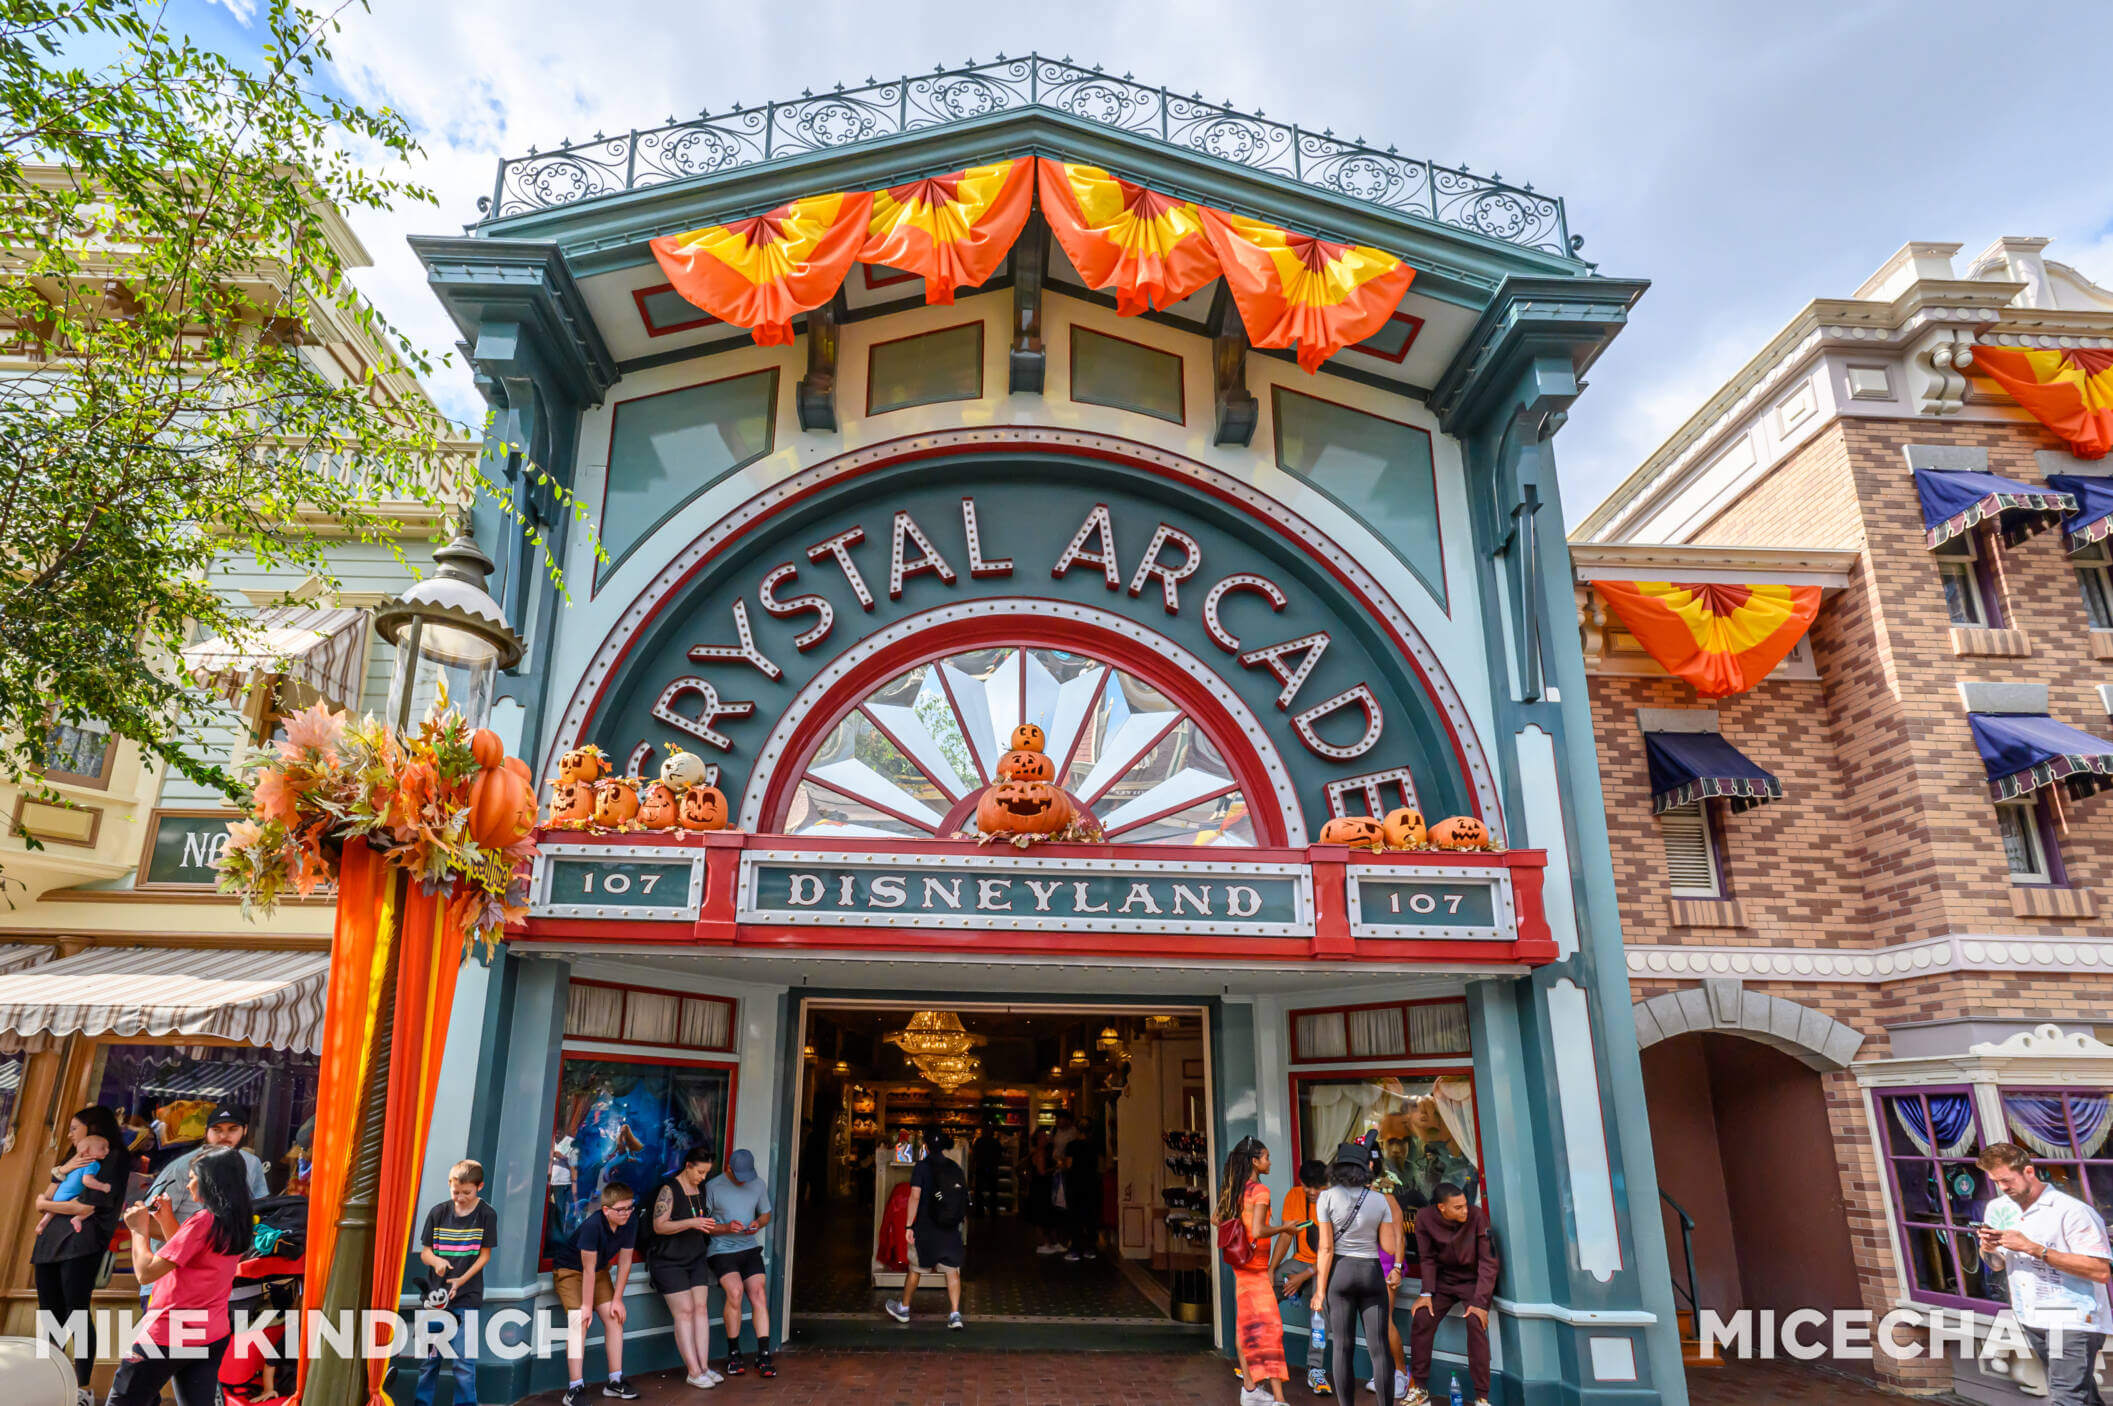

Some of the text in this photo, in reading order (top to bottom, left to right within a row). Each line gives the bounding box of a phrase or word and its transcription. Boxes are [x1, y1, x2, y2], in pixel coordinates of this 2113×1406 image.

[1052, 503, 1423, 824] ARCADE
[582, 871, 663, 895] 107
[787, 873, 1264, 917] DISNEYLAND
[1388, 891, 1465, 915] 107
